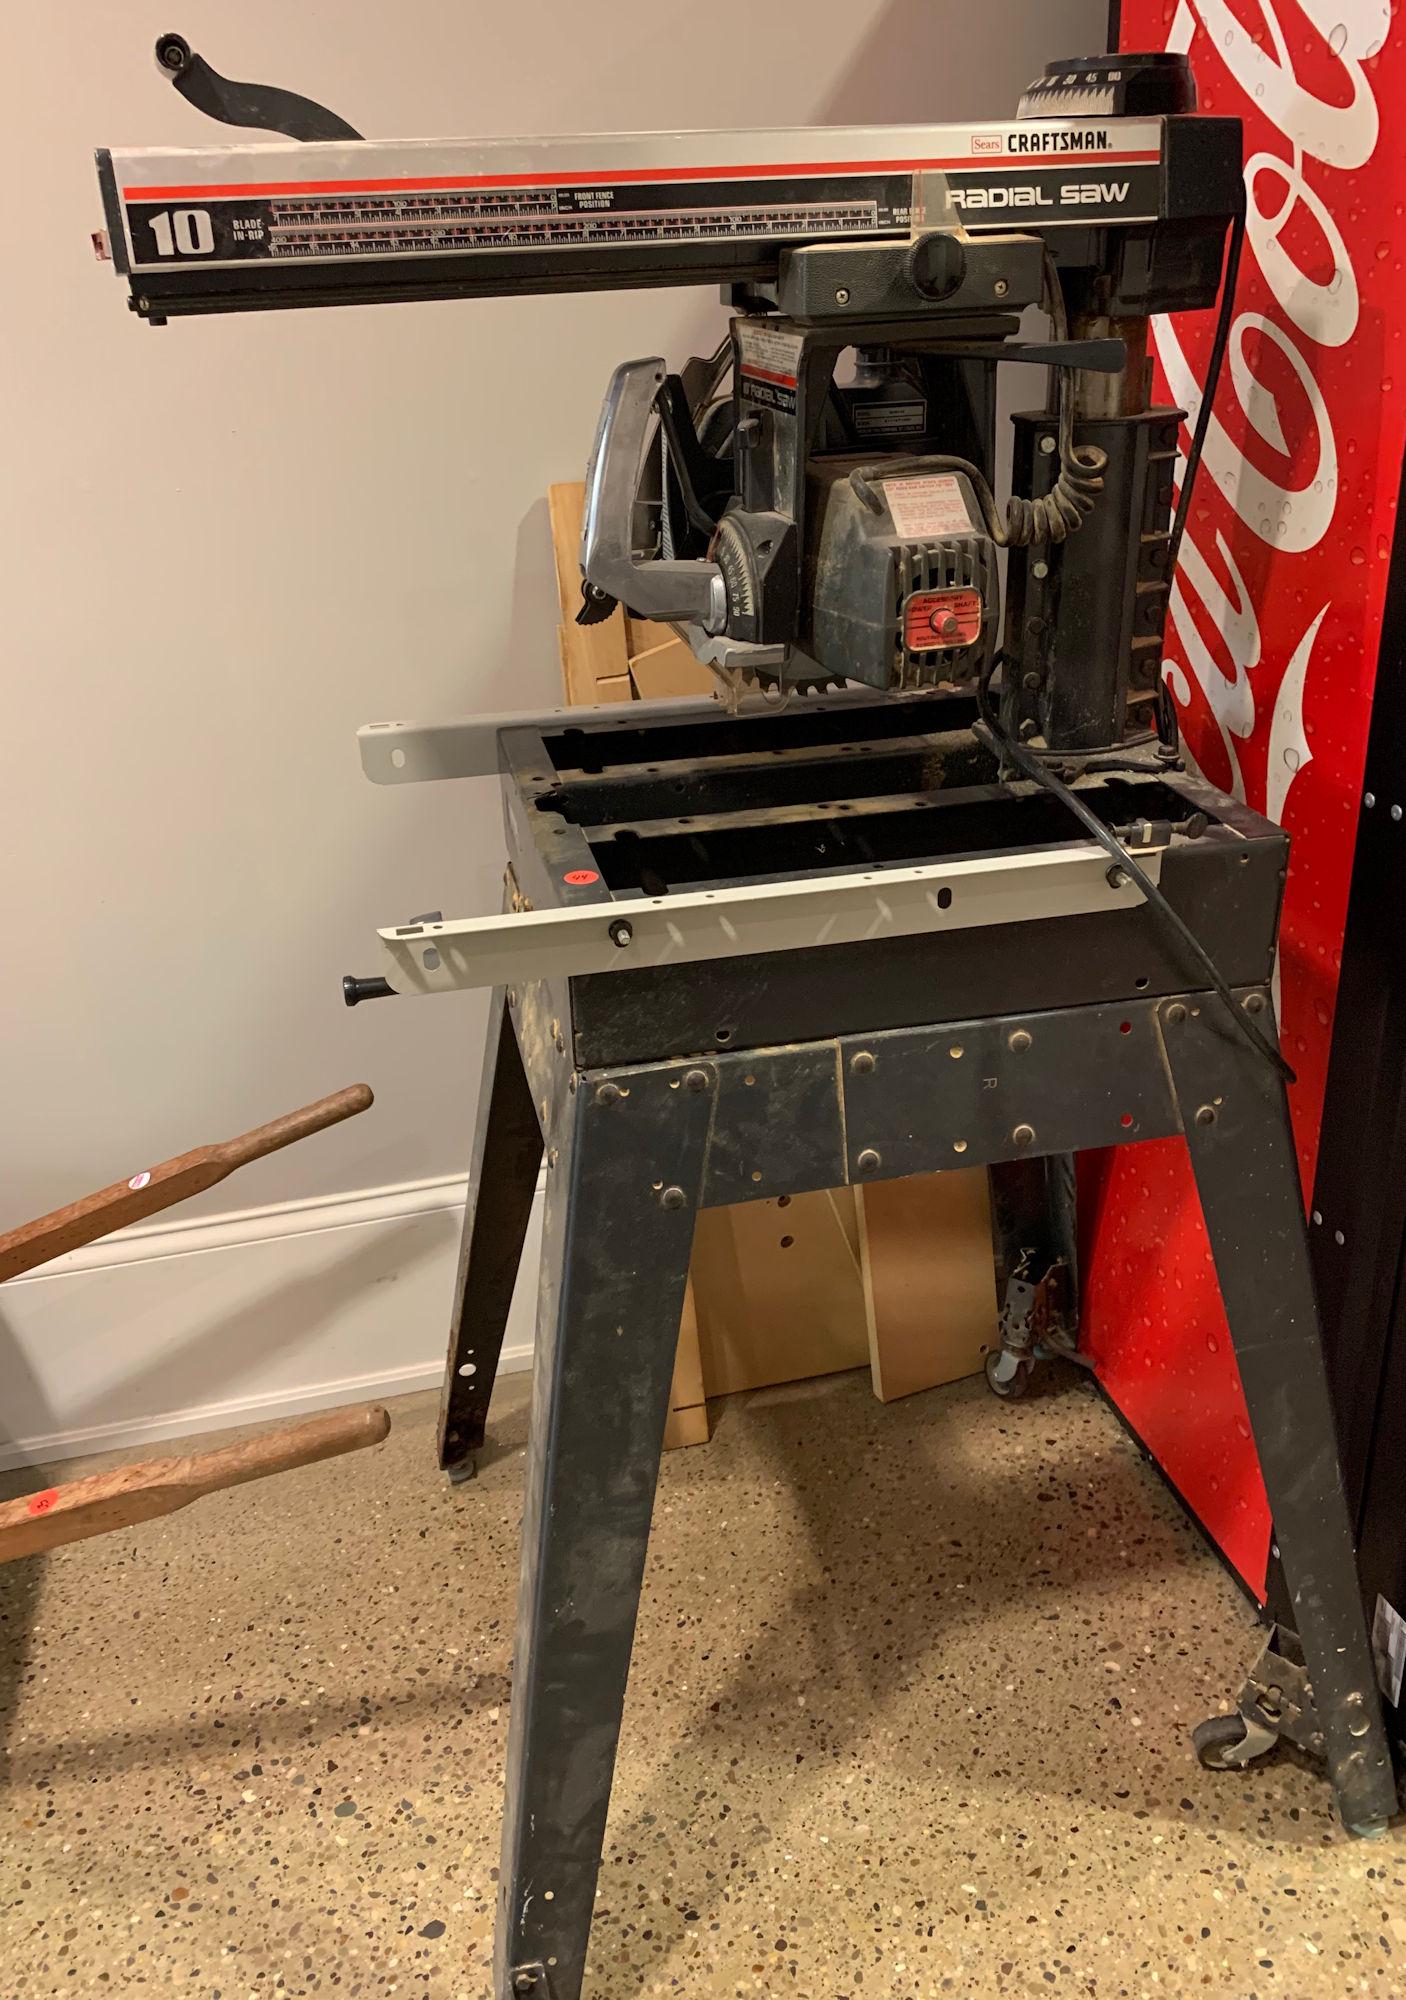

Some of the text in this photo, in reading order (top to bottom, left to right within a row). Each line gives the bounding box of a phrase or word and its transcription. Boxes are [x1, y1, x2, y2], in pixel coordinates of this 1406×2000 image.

[1086, 73, 1099, 83] 45
[974, 138, 1000, 150] Sears
[579, 200, 610, 208] POSITION
[233, 219, 262, 230] BLADE
[148, 210, 215, 256] 10
[983, 1077, 998, 1090] R
